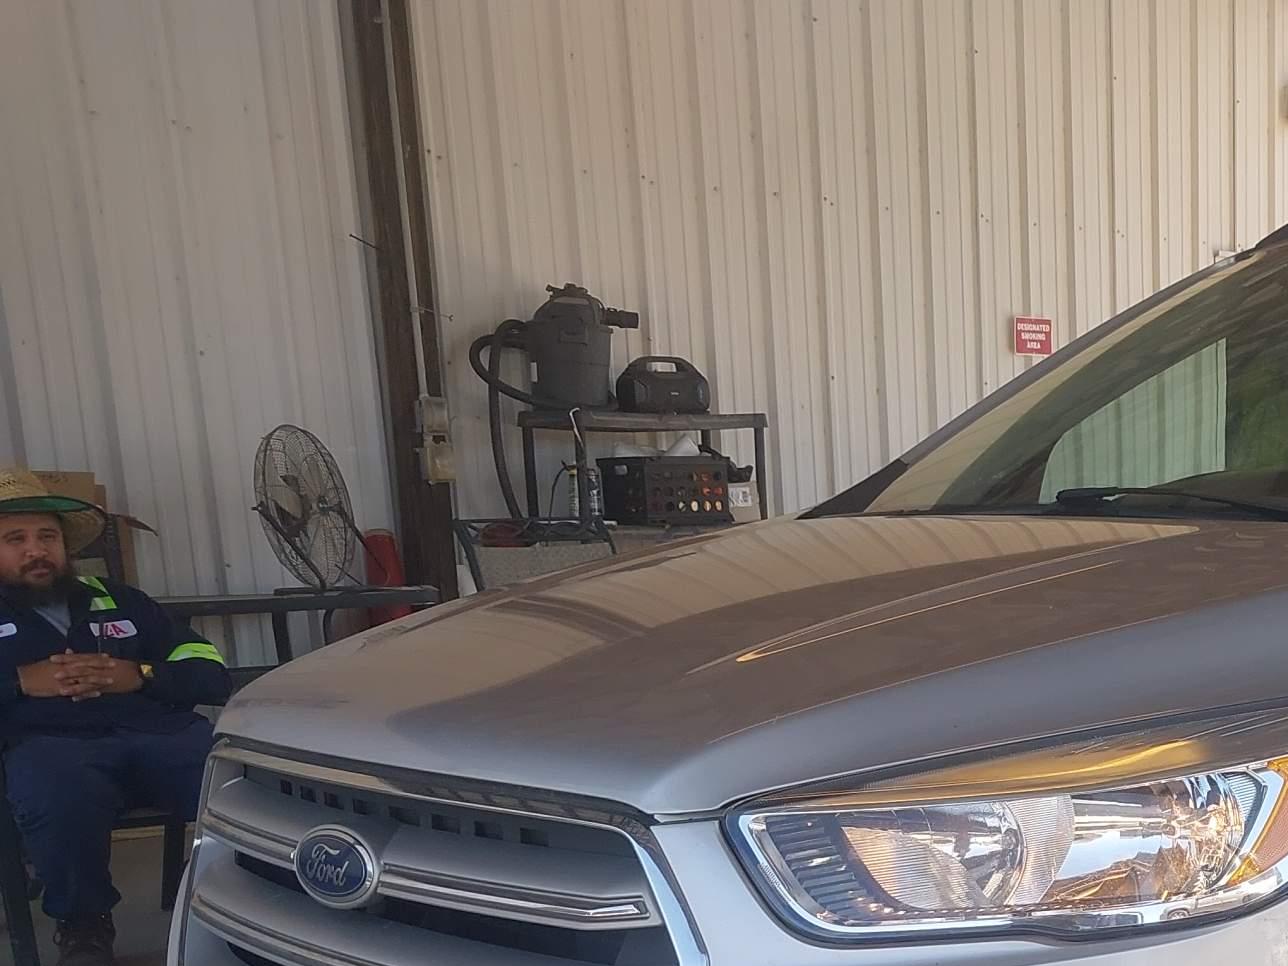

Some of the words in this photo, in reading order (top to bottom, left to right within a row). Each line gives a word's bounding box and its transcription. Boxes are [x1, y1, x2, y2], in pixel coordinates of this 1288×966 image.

[1017, 323, 1050, 332] DESIGNATED
[1021, 332, 1046, 341] SMOKING
[1026, 341, 1041, 349] AREA
[306, 843, 350, 886] Ford
